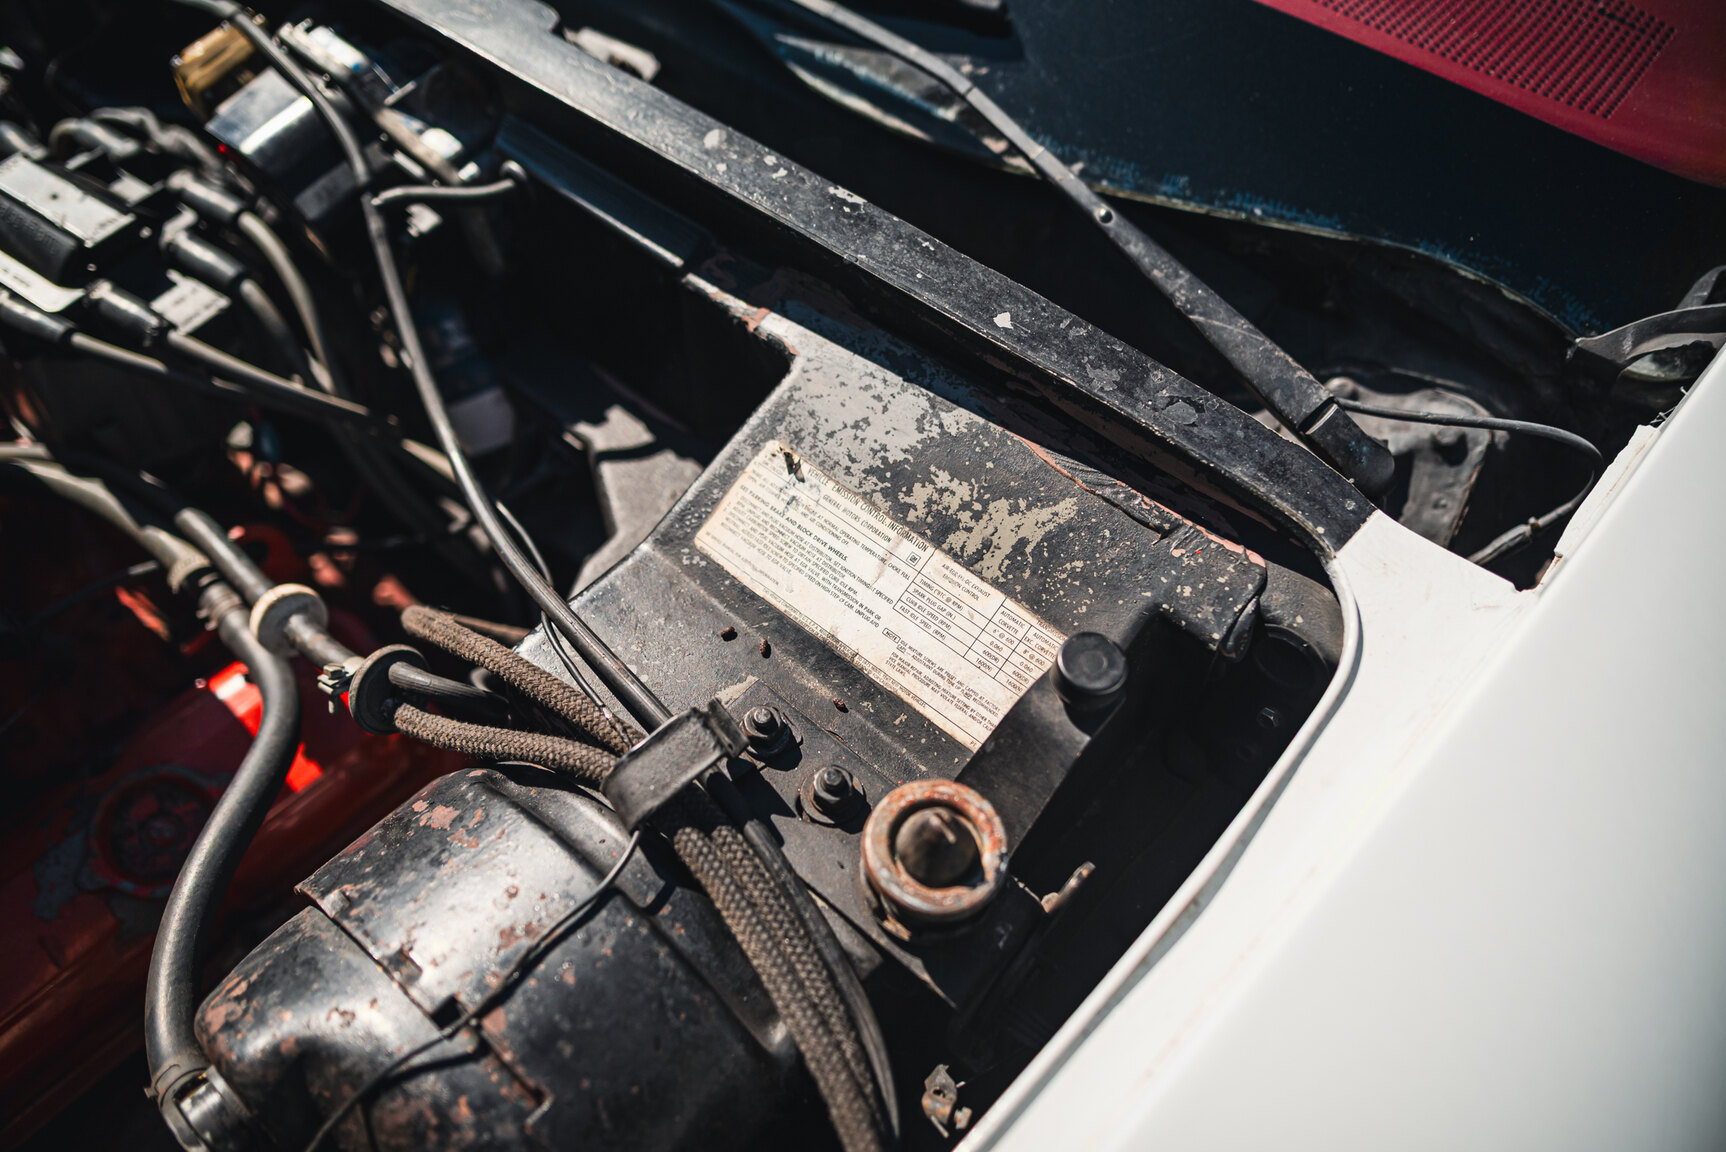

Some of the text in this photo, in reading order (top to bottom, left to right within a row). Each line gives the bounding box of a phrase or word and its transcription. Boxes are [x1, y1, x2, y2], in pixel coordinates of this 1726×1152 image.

[805, 466, 831, 486] VEHICLE
[830, 482, 861, 506] EMISSION
[886, 520, 930, 552] INFORMATION
[821, 493, 892, 544] GENERAL MOTORS CORPORATION
[784, 515, 798, 526] AND
[796, 523, 813, 537] BLOCK
[811, 534, 828, 548] DRIVE
[826, 544, 849, 562] WHEELS.
[822, 517, 840, 531] NORMAL
[838, 528, 861, 546] OPERATING
[886, 561, 902, 574] CHOKE
[899, 570, 911, 581] FULL
[798, 560, 808, 569] EGR
[820, 575, 832, 586] WITH
[830, 583, 859, 605] TRANSMISSION
[862, 605, 875, 616] PARK
[873, 613, 882, 621] OR
[810, 560, 830, 576] SPECIFIED
[828, 572, 840, 583] CURB
[838, 579, 849, 589] IDLE
[846, 585, 859, 597] RPM.
[832, 559, 841, 568] SET
[854, 575, 871, 589] TIMING
[874, 588, 894, 605] SPECIFIED
[918, 578, 935, 591] TIMING
[950, 600, 964, 611] RPM)
[960, 585, 980, 601] CONTROL
[813, 579, 822, 587] ON
[819, 583, 831, 594] HIGH
[829, 590, 839, 600] STEP
[853, 607, 871, 622] UNPLUG
[904, 595, 952, 631] CURB IDLE SPEED (RPM)
[911, 587, 926, 600] SPARK
[924, 596, 938, 608] PLUG
[935, 604, 947, 614] GAP
[884, 630, 897, 641] NOTE
[898, 604, 947, 641] FAST IDLE SPEED (RPM)
[997, 617, 1019, 634] CORVETTE
[999, 609, 1025, 629] AUTOMATIC
[981, 648, 1000, 664] 600(DR)
[988, 640, 1003, 652] 0.060
[1004, 636, 1015, 646] 600
[1032, 631, 1059, 651] AUTOMATIC
[1033, 642, 1057, 660] CORVETTE
[884, 659, 896, 669] STATE
[896, 643, 907, 653] CAPS
[910, 653, 933, 671] ADJUSTMENT
[931, 668, 947, 681] DURING
[945, 678, 955, 687] TUNE
[963, 691, 973, 699] NOT
[906, 644, 923, 658] MIXTURE
[922, 655, 937, 668] SCREWS
[935, 665, 944, 673] ARE
[943, 670, 957, 682] PRESET
[955, 679, 965, 688] AND
[964, 684, 979, 698] CAPPED
[983, 698, 1001, 713] FACTORY
[974, 657, 993, 673] 1600(N)
[1033, 656, 1045, 667] 600
[887, 655, 897, 664] VICE
[895, 661, 912, 674] MANUAL
[910, 671, 931, 688] PROCEDURE
[929, 685, 940, 694] MAY
[939, 692, 954, 705] VIOLATE
[953, 702, 969, 715] FEDERAL
[890, 651, 899, 659] FOR
[897, 656, 911, 667] MAJOR
[922, 673, 942, 690] ADJUSTING
[940, 686, 957, 700] MIXTURE
[955, 697, 971, 710] SETTING
[974, 710, 988, 722] OTHER
